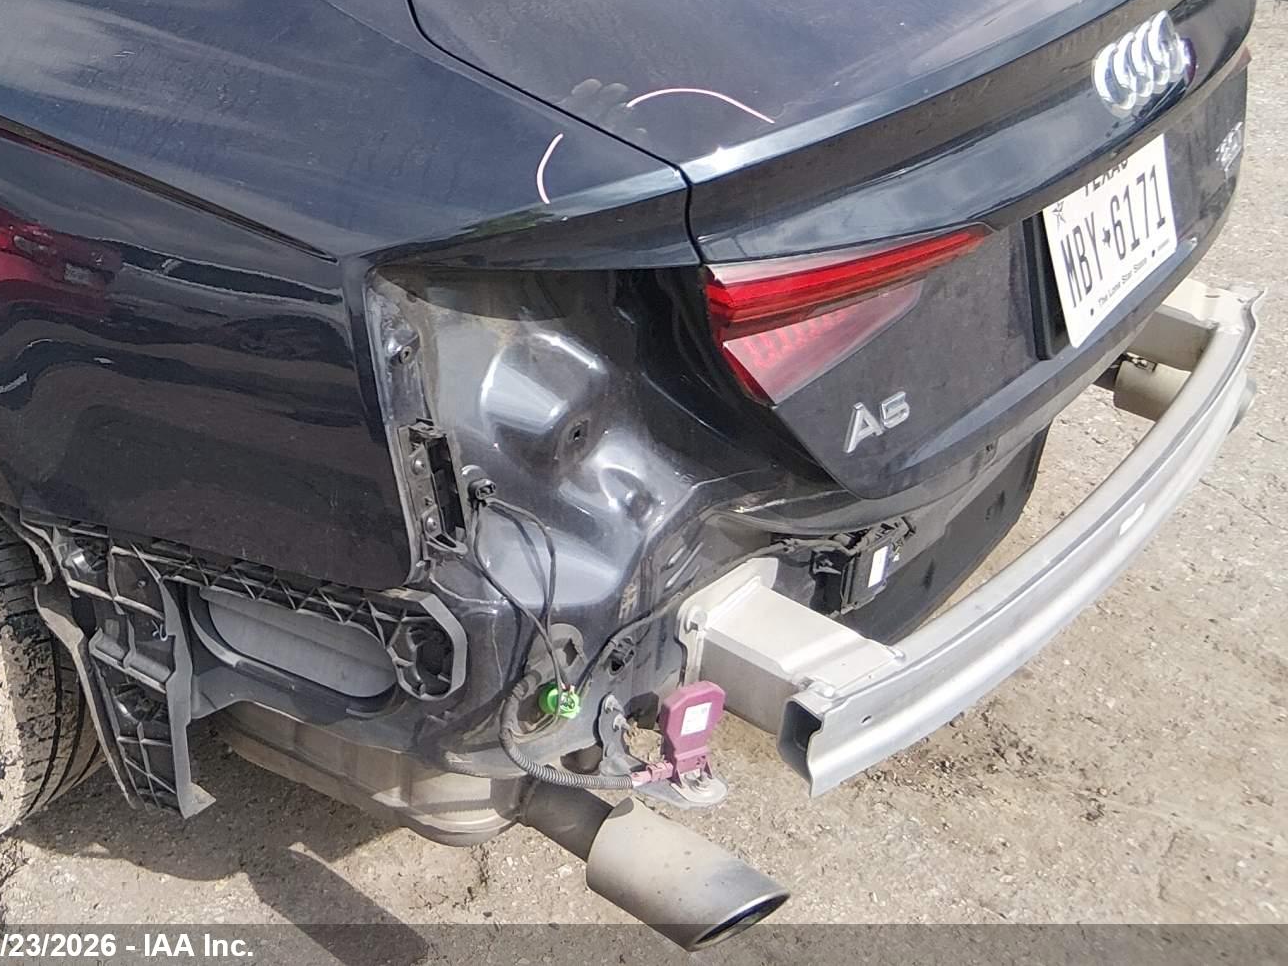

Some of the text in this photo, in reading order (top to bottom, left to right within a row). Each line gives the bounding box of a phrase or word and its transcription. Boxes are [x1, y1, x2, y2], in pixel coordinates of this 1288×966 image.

[1060, 165, 1166, 308] MBY 6171
[841, 391, 910, 453] A5
